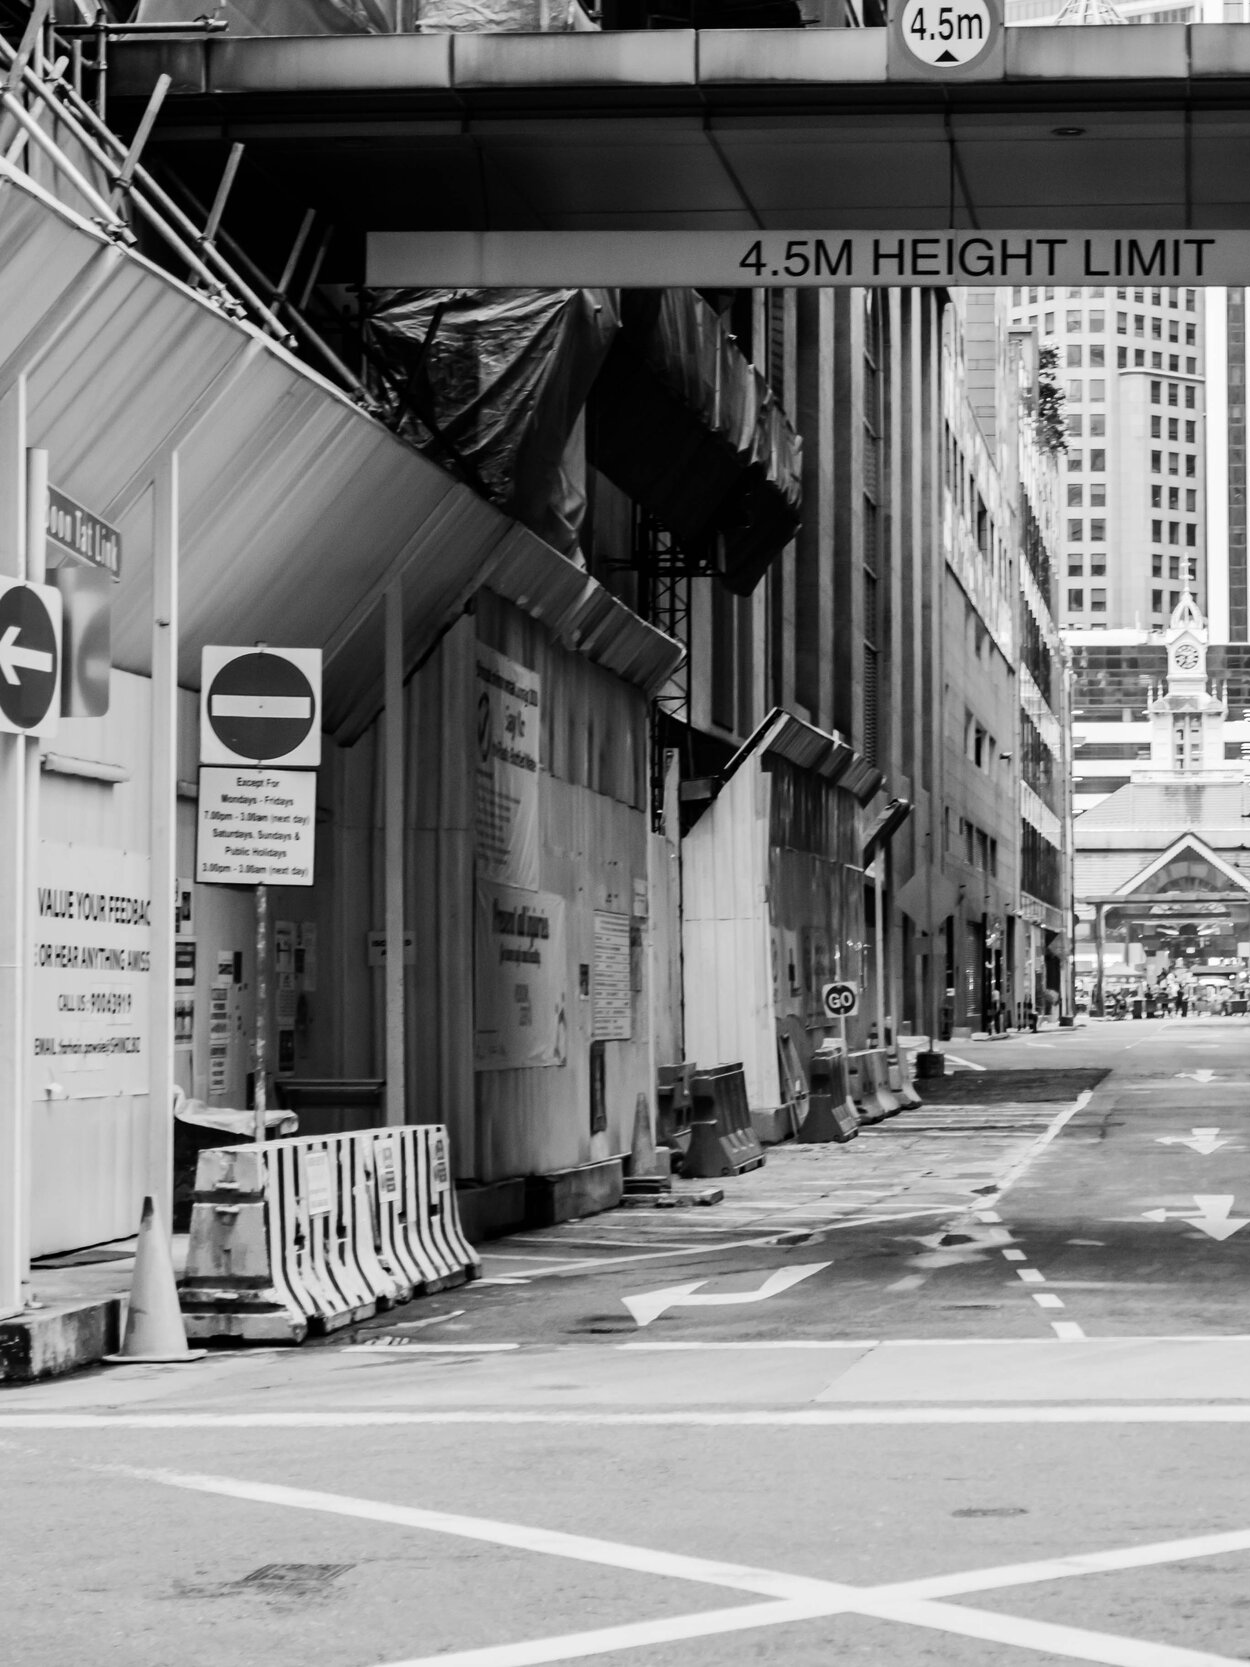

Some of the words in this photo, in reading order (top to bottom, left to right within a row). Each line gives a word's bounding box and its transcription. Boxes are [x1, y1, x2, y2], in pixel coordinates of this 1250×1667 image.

[911, 7, 982, 40] 4.5m
[739, 238, 854, 277] 4.5M
[873, 238, 1067, 277] HEIGHT
[1083, 238, 1215, 276] LIMIT
[236, 777, 264, 788] Except
[266, 779, 280, 787] For
[221, 794, 257, 806] Mondays
[264, 796, 294, 807] Fridays
[258, 830, 291, 842] Sundays
[225, 846, 250, 856] Public
[252, 848, 287, 859] Holidays
[38, 887, 74, 919] VALUE
[76, 892, 106, 922] YOUR
[39, 943, 52, 967] OR
[55, 944, 79, 969] HEAR
[81, 946, 125, 971] ANYTHING
[828, 991, 853, 1008] GO
